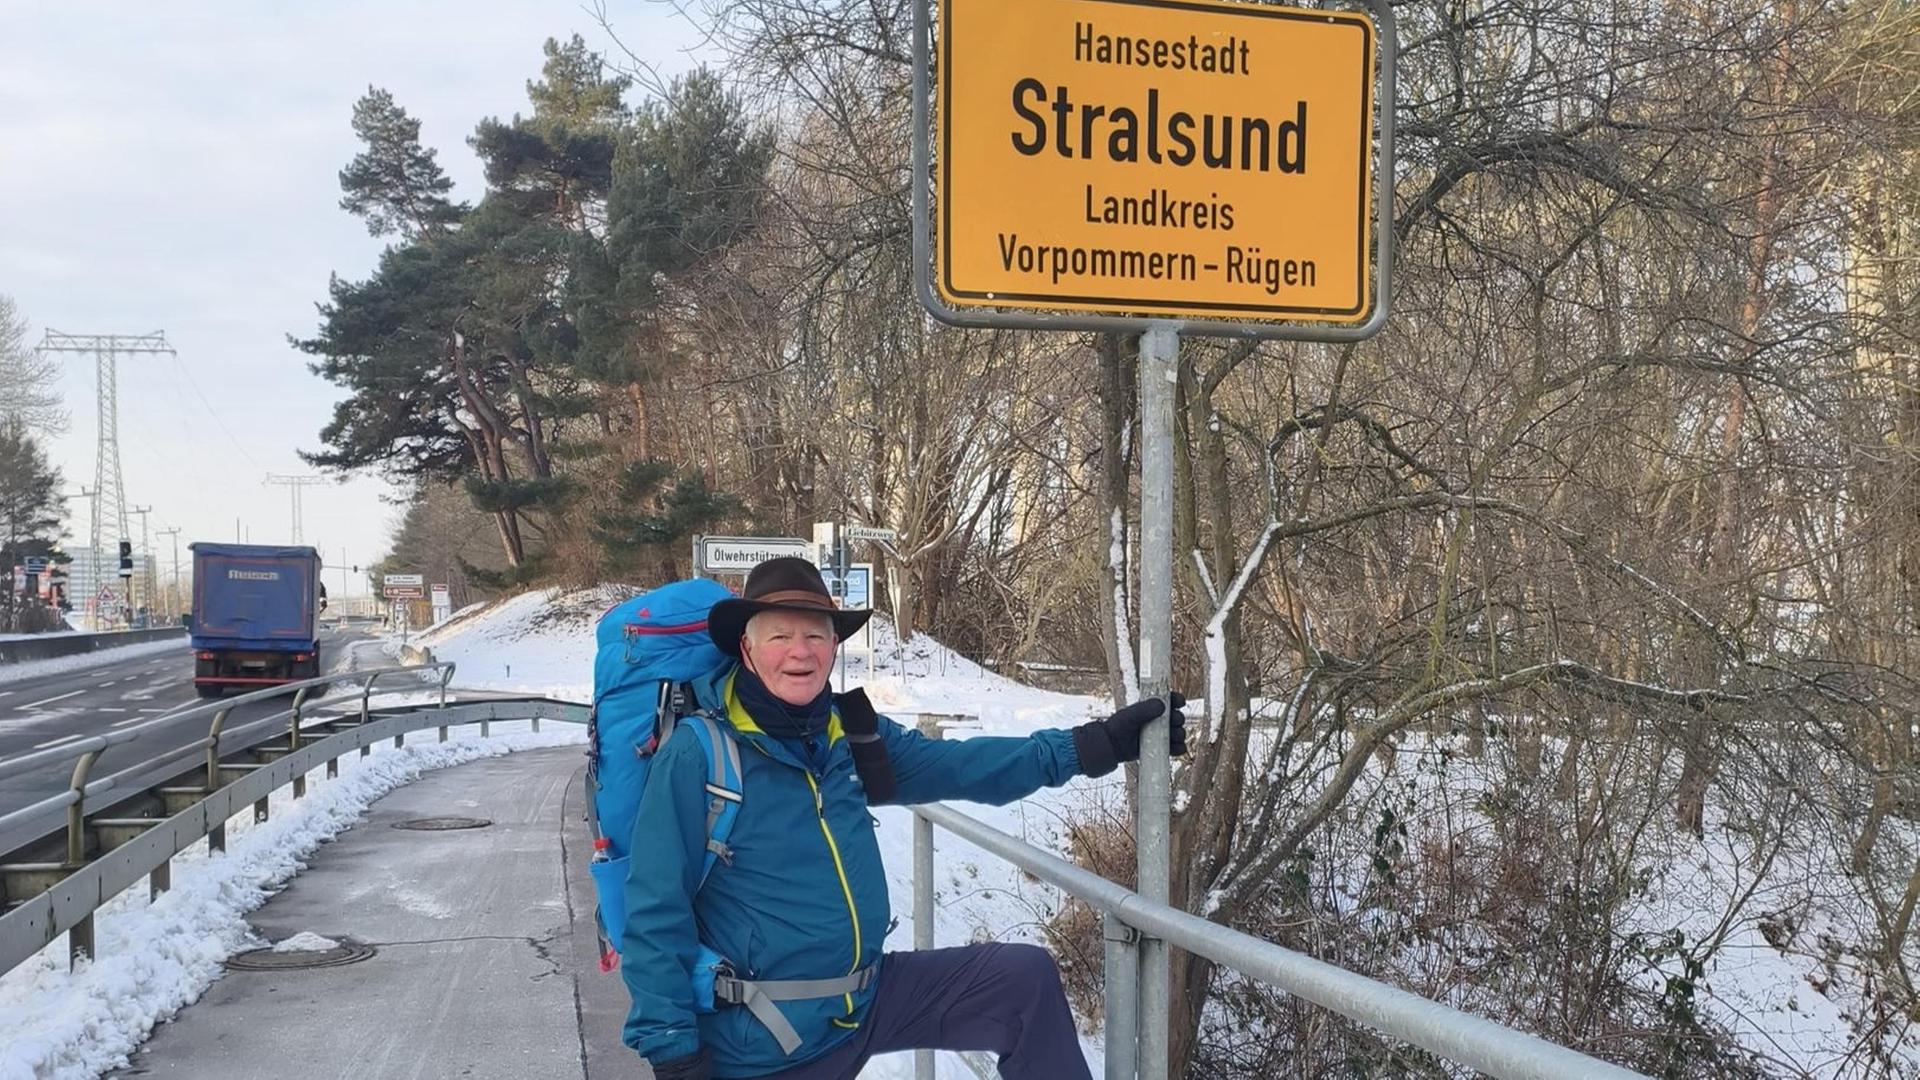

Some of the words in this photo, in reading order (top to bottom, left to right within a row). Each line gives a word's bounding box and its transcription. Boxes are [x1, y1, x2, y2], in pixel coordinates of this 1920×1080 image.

[1075, 21, 1250, 76] Hansestadt
[1011, 77, 1307, 175] Stralsund
[1086, 184, 1234, 231] Landkreis
